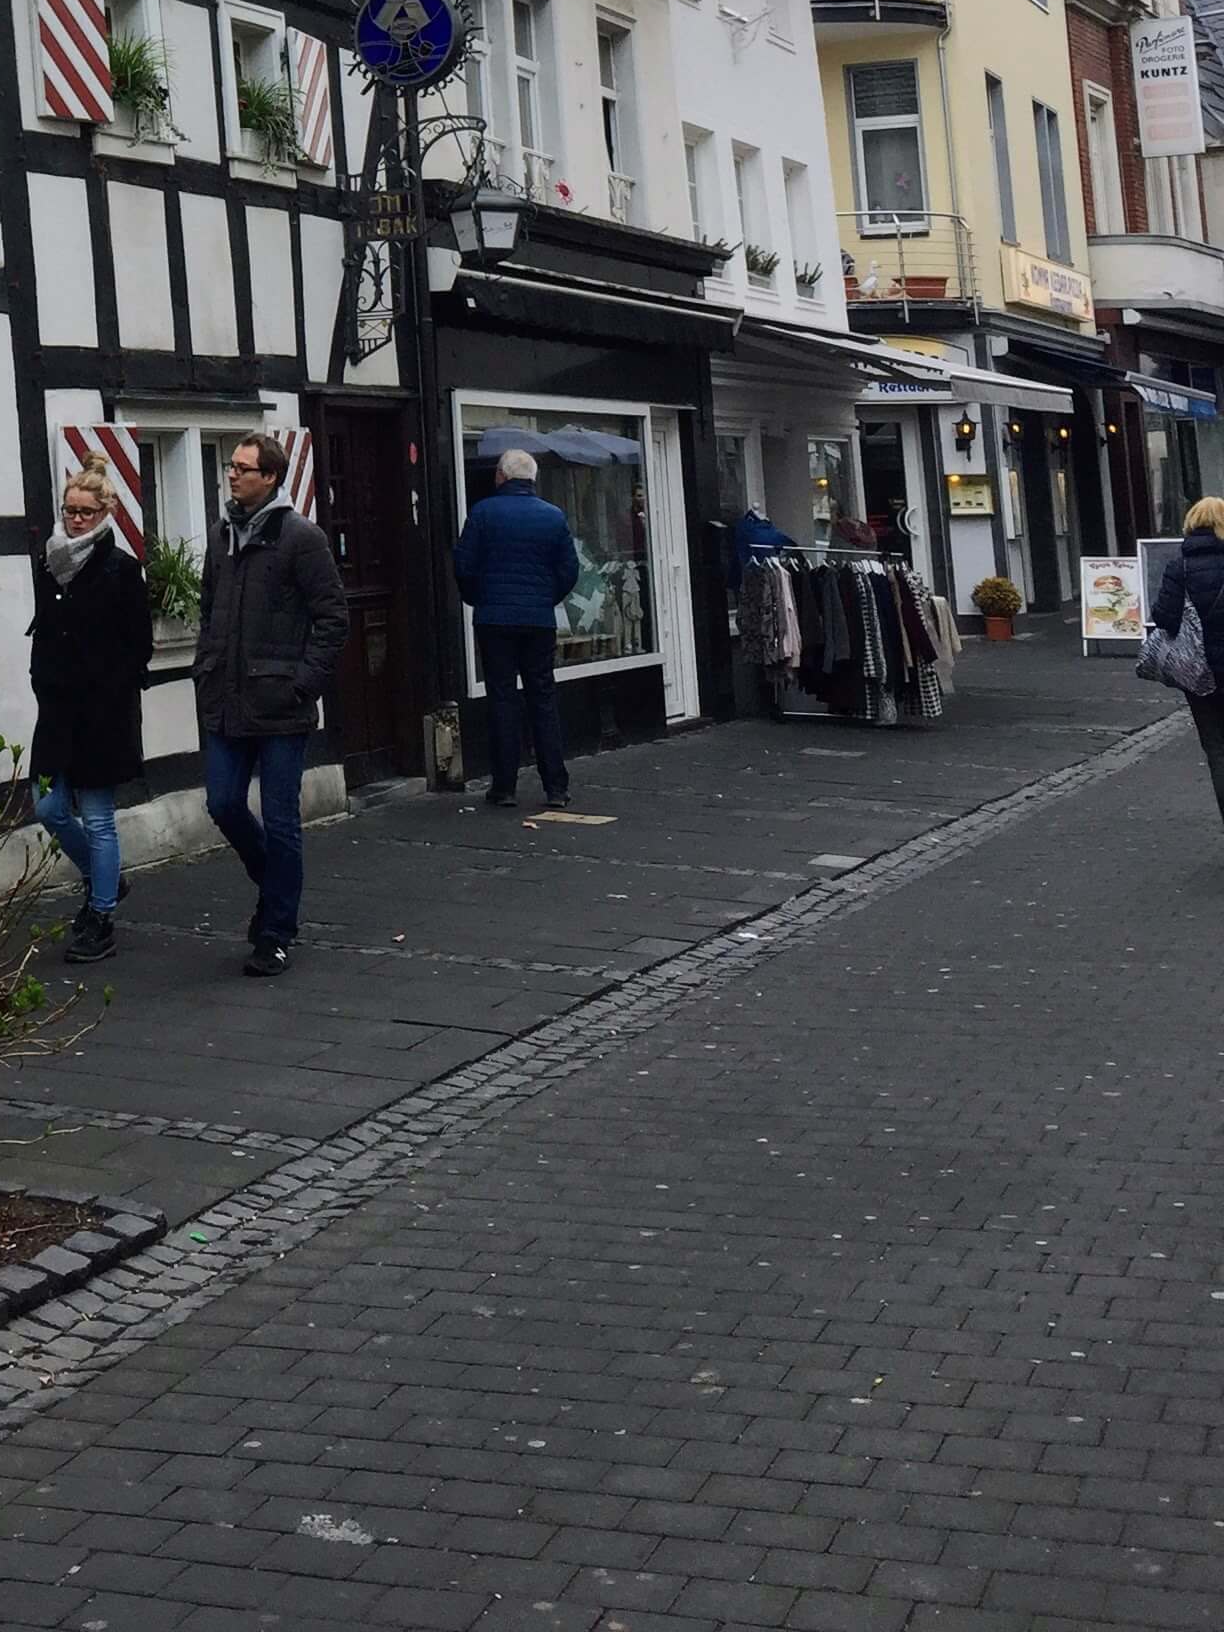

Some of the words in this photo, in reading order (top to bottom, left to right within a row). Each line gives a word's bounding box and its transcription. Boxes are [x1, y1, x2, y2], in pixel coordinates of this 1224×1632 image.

[1162, 45, 1185, 53] FOTO
[1141, 53, 1185, 64] DROGERIE
[1140, 66, 1188, 79] KUNTZ
